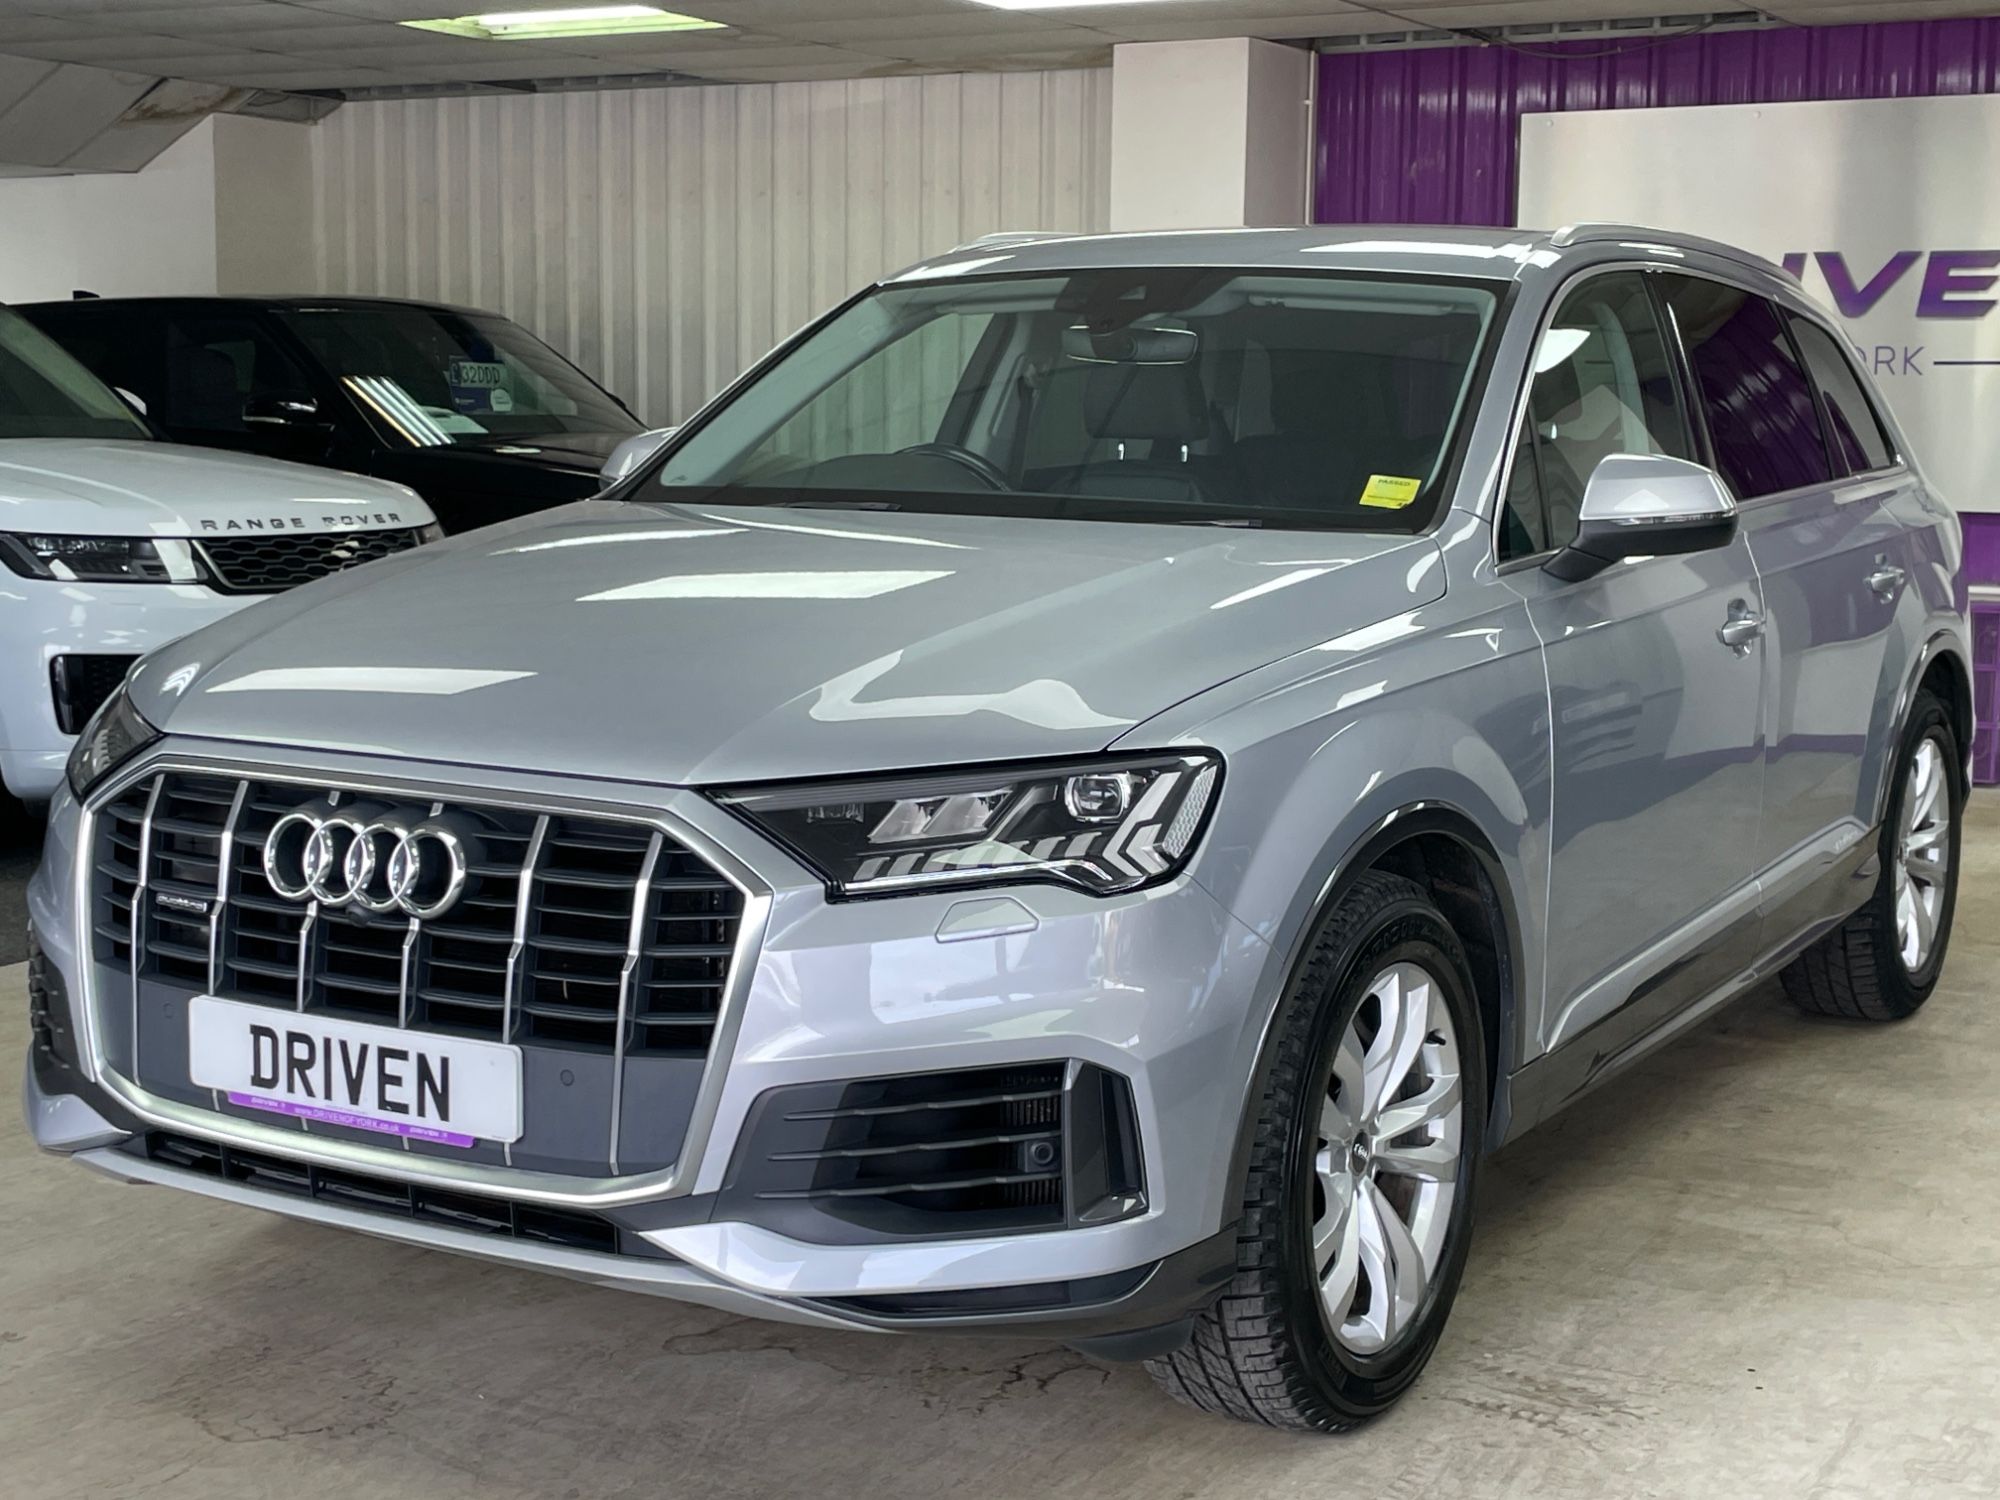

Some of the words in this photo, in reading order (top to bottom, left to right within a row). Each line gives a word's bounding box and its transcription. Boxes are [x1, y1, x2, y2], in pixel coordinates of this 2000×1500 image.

[1855, 346, 1925, 376] RK
[201, 517, 305, 530] RANGE
[322, 512, 402, 527] ROVER
[249, 1024, 450, 1122] DRIVEN
